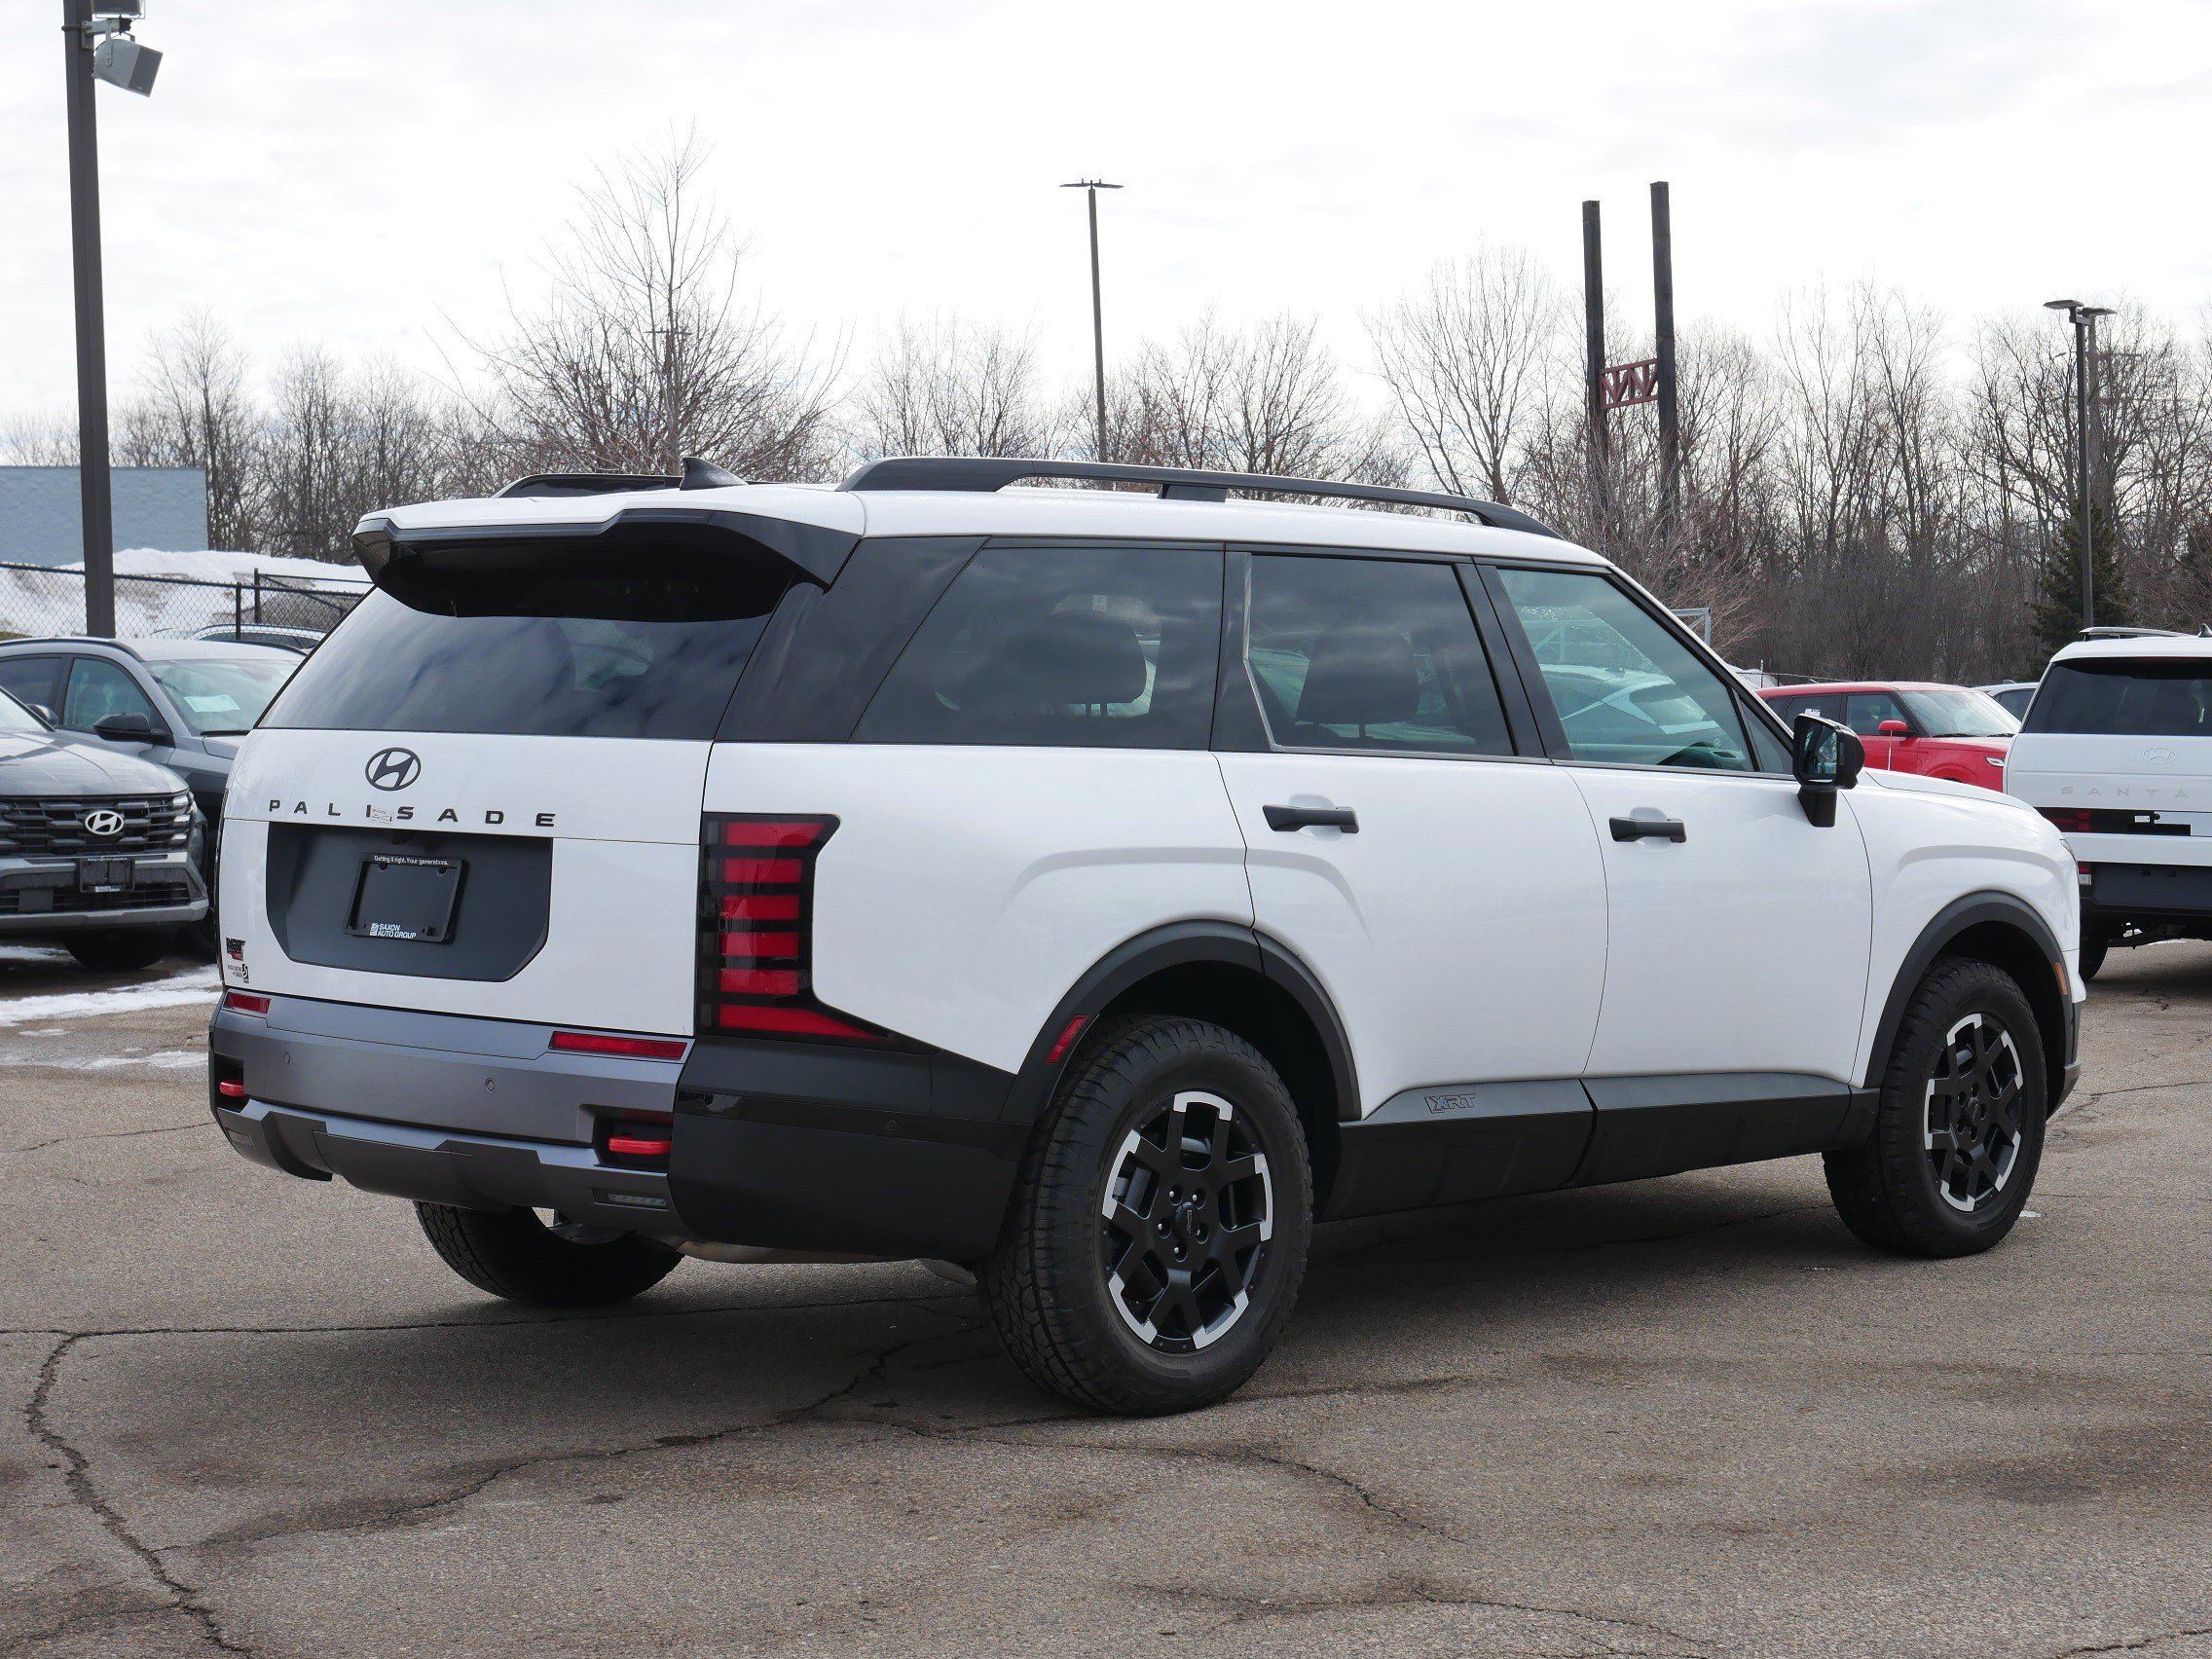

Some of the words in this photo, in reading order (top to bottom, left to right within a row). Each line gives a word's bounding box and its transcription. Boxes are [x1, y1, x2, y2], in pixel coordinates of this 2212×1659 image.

[2061, 787, 2190, 798] SANTA
[269, 799, 556, 828] PALISADE
[394, 931, 417, 940] GROUP
[1423, 1093, 1477, 1114] XRT
